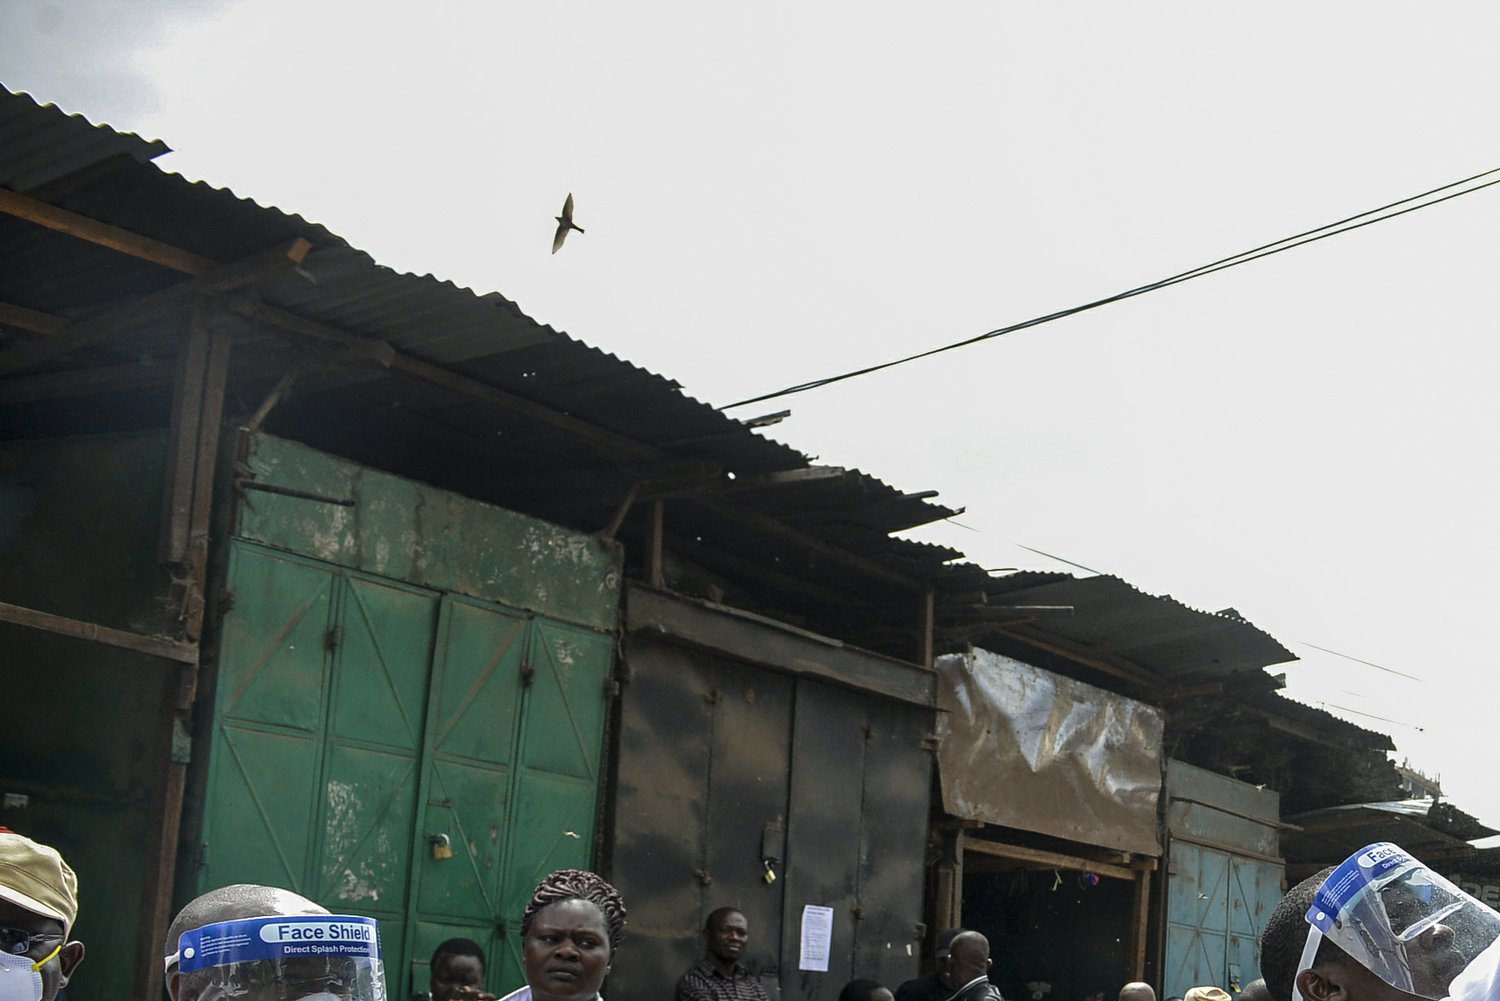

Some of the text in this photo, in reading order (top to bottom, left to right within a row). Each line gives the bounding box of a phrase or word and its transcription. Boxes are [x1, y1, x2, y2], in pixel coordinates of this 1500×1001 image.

[278, 924, 324, 940] Face
[328, 924, 371, 941] Shield
[284, 945, 370, 955] Direct Splash Protection
